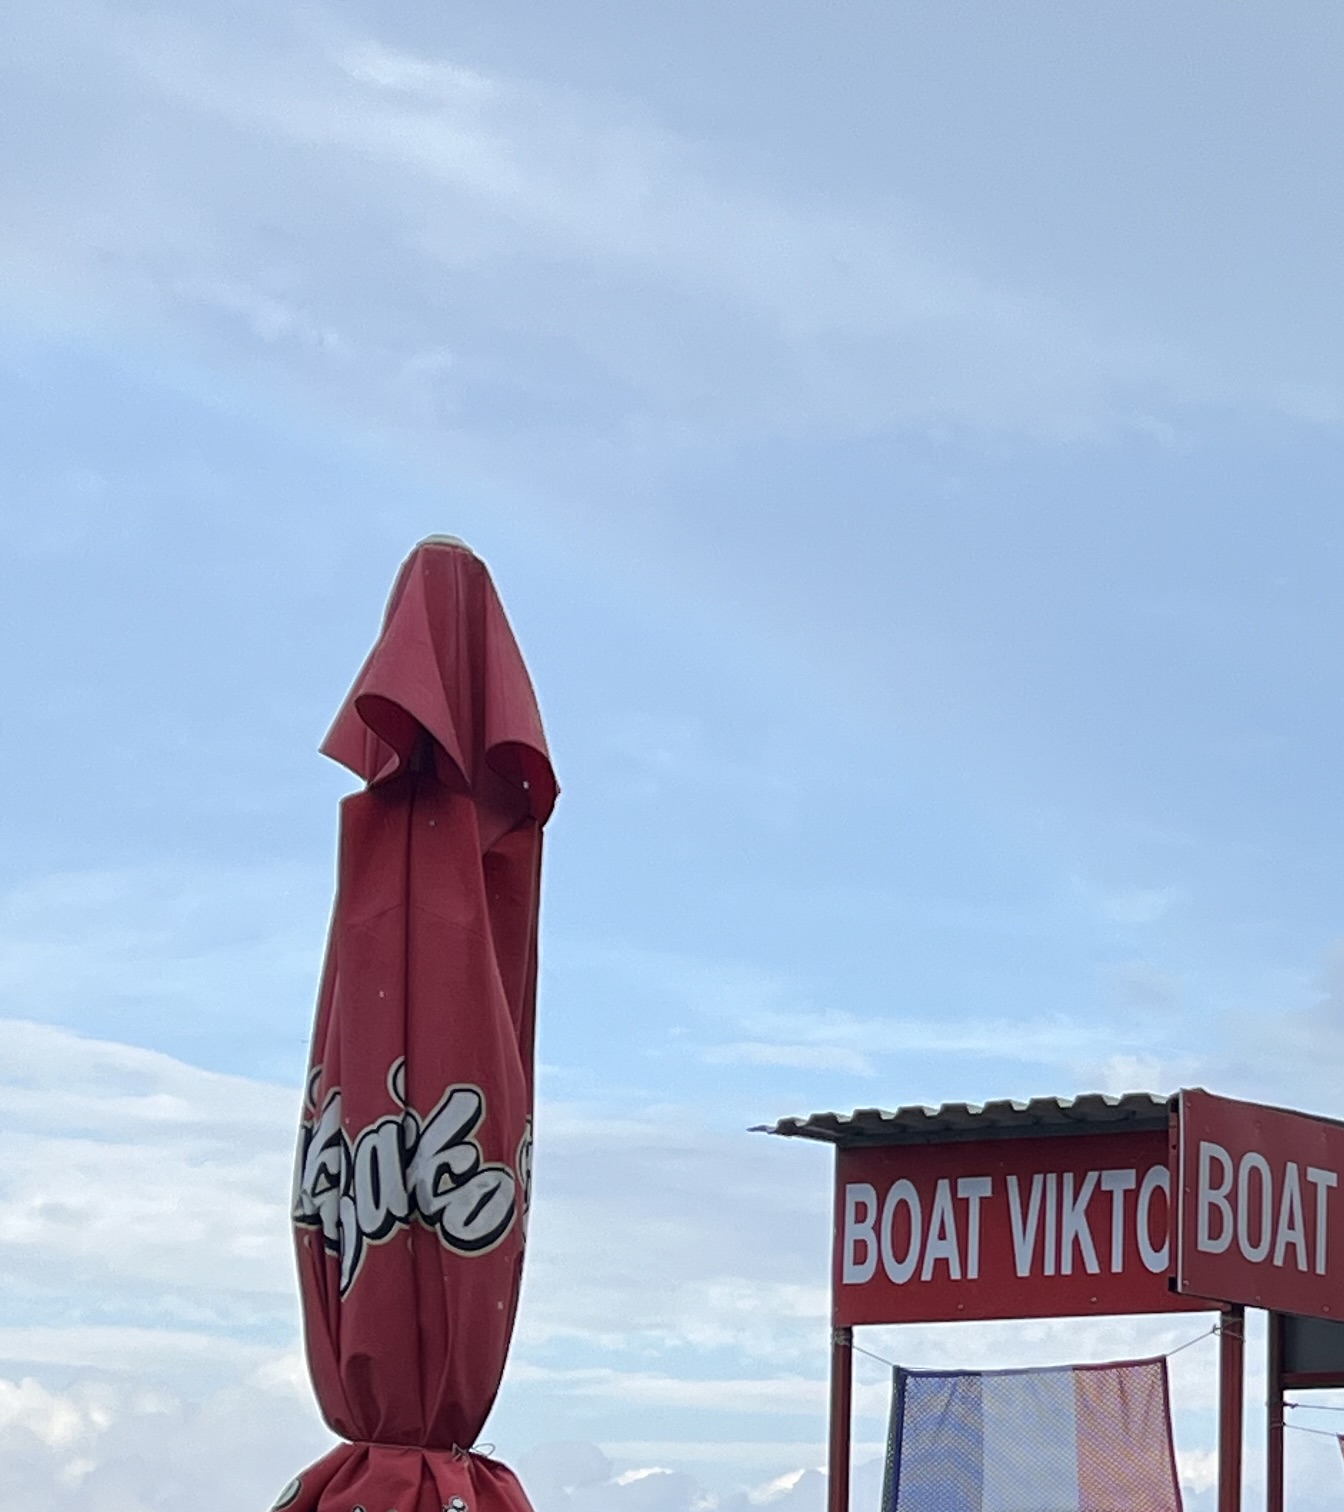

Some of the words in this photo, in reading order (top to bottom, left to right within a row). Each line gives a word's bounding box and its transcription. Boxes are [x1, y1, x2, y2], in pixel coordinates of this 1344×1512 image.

[843, 1176, 993, 1286] BOAT
[1006, 1166, 1170, 1280] VIKTO
[1197, 1141, 1340, 1276] BOAT
